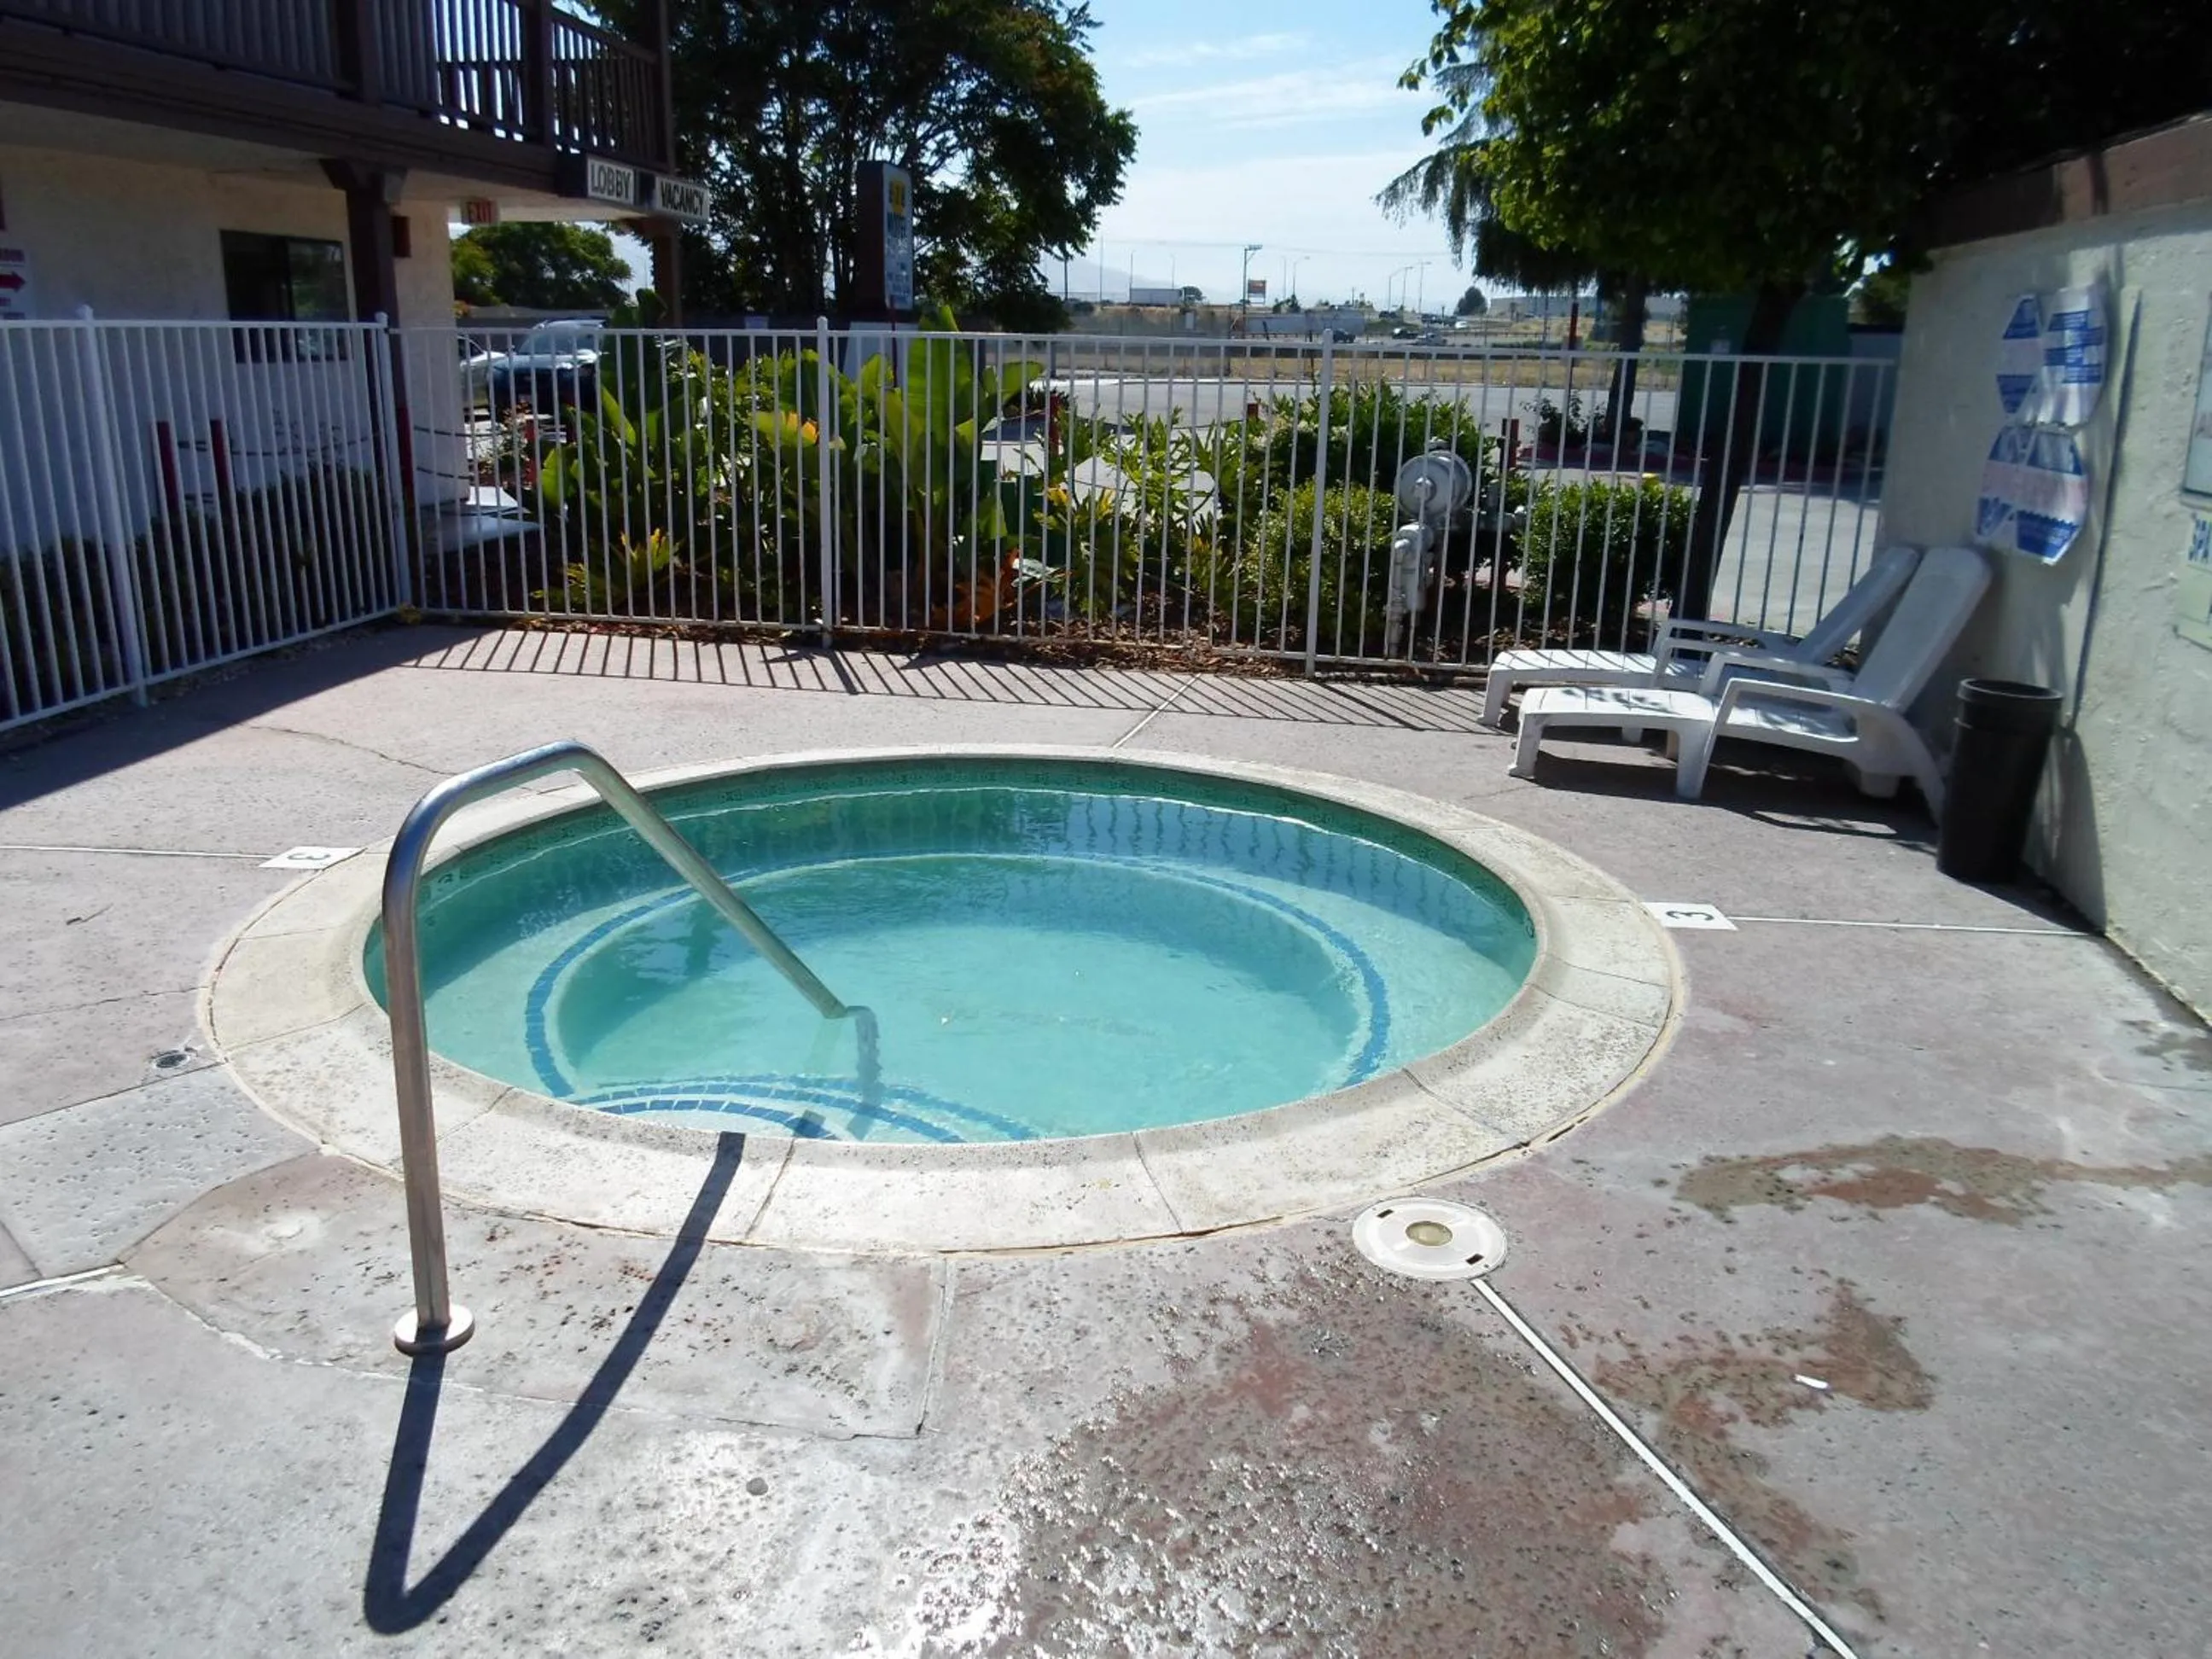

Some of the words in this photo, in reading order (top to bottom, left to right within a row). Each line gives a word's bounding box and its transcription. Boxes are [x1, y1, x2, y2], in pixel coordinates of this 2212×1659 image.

[591, 163, 632, 199] LOBBY
[660, 180, 704, 216] VACANCY
[466, 201, 492, 225] EXIT
